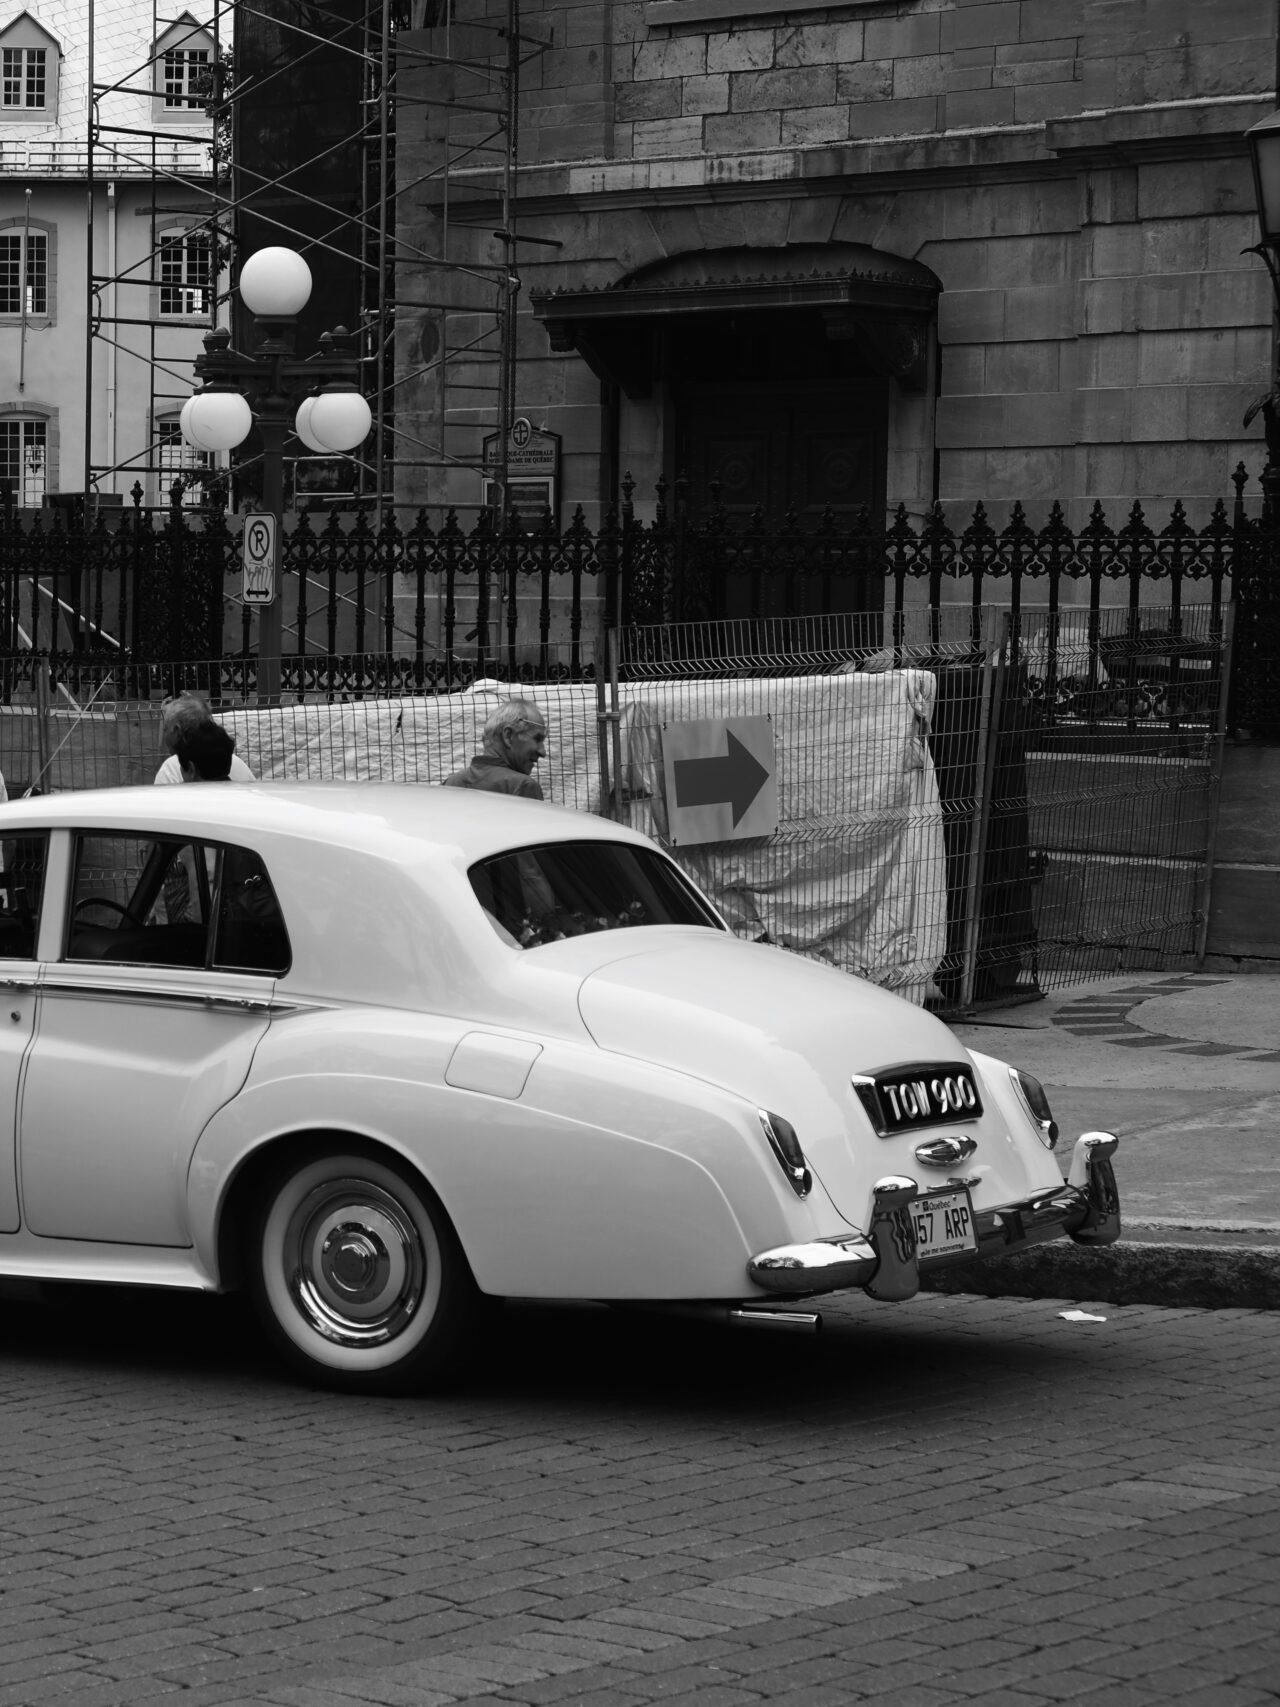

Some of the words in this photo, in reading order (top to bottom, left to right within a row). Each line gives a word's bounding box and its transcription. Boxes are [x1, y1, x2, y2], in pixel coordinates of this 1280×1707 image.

[882, 1080, 931, 1121] TOW
[931, 1074, 976, 1114] 900
[929, 1200, 951, 1211] Québec
[945, 1206, 969, 1240] ARP
